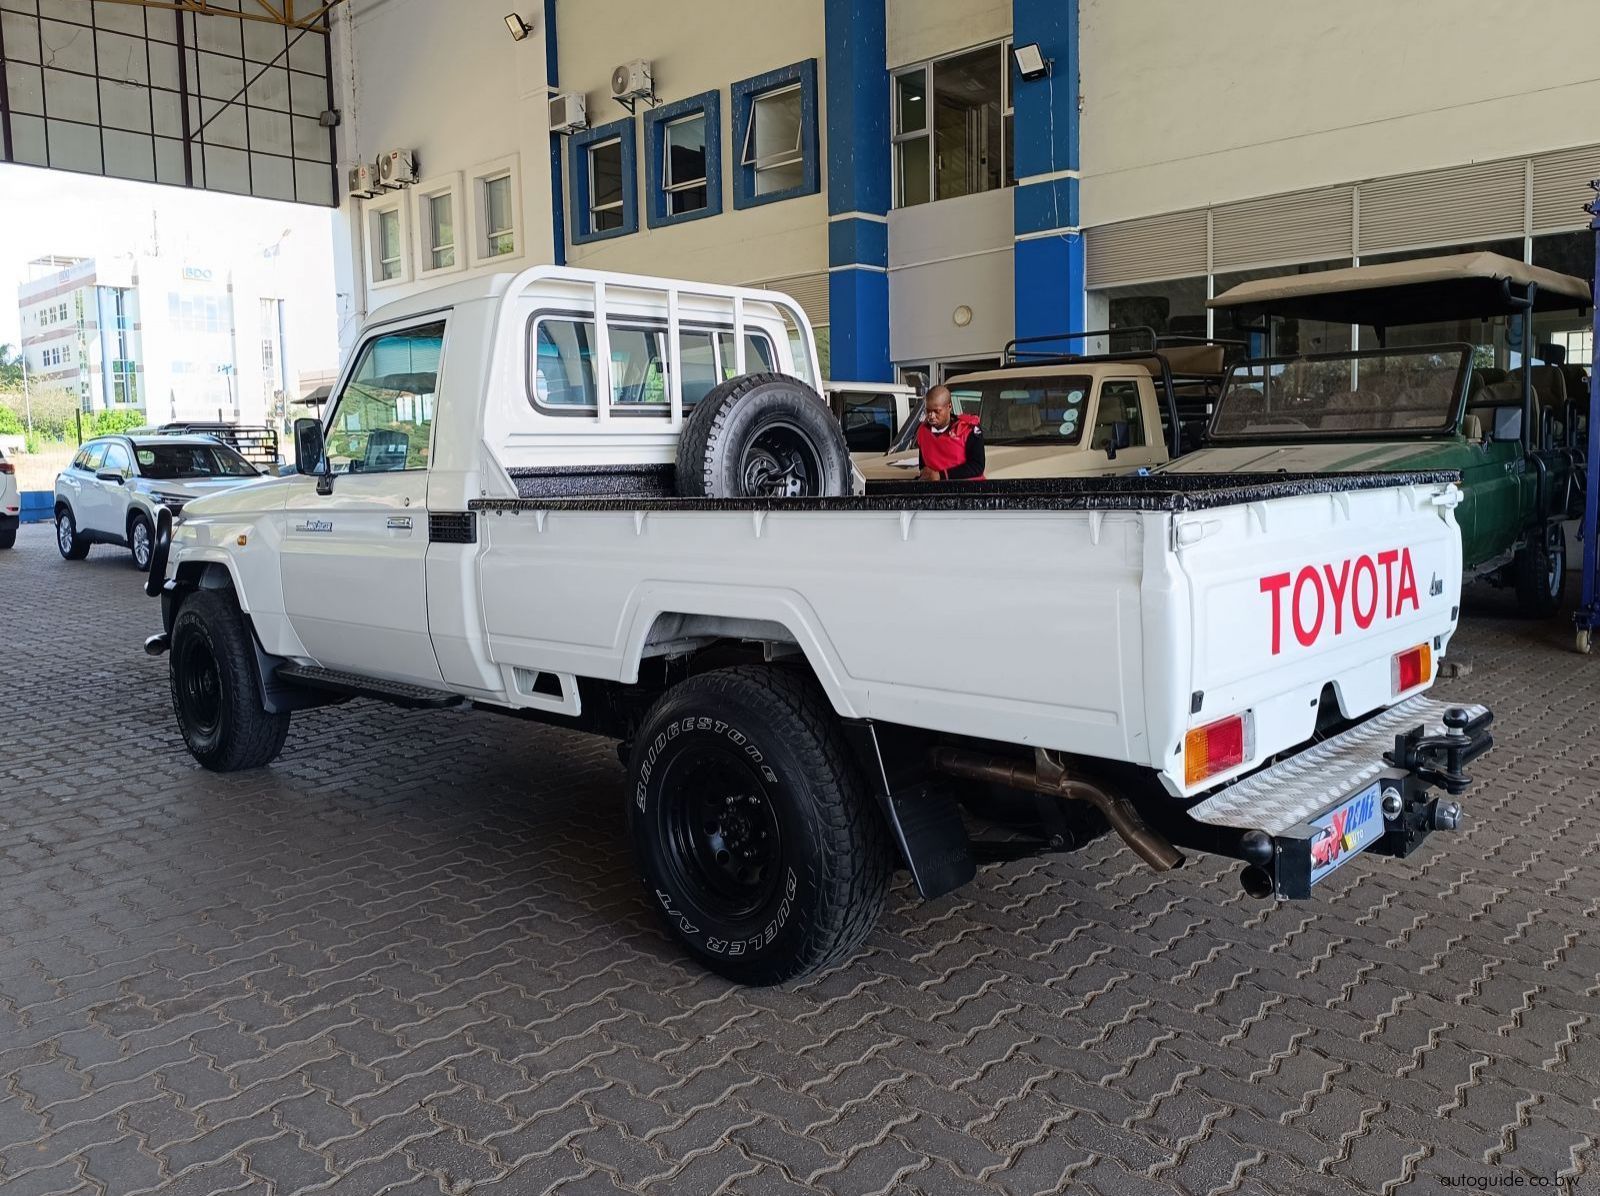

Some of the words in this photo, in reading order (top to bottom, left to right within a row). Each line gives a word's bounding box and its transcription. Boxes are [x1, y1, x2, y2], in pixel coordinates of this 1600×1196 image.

[185, 267, 213, 279] BDO
[1259, 547, 1420, 655] TOYOTA
[635, 716, 779, 814] BRIDGESTONE
[655, 889, 700, 934] A/T
[706, 866, 797, 956] DUELER
